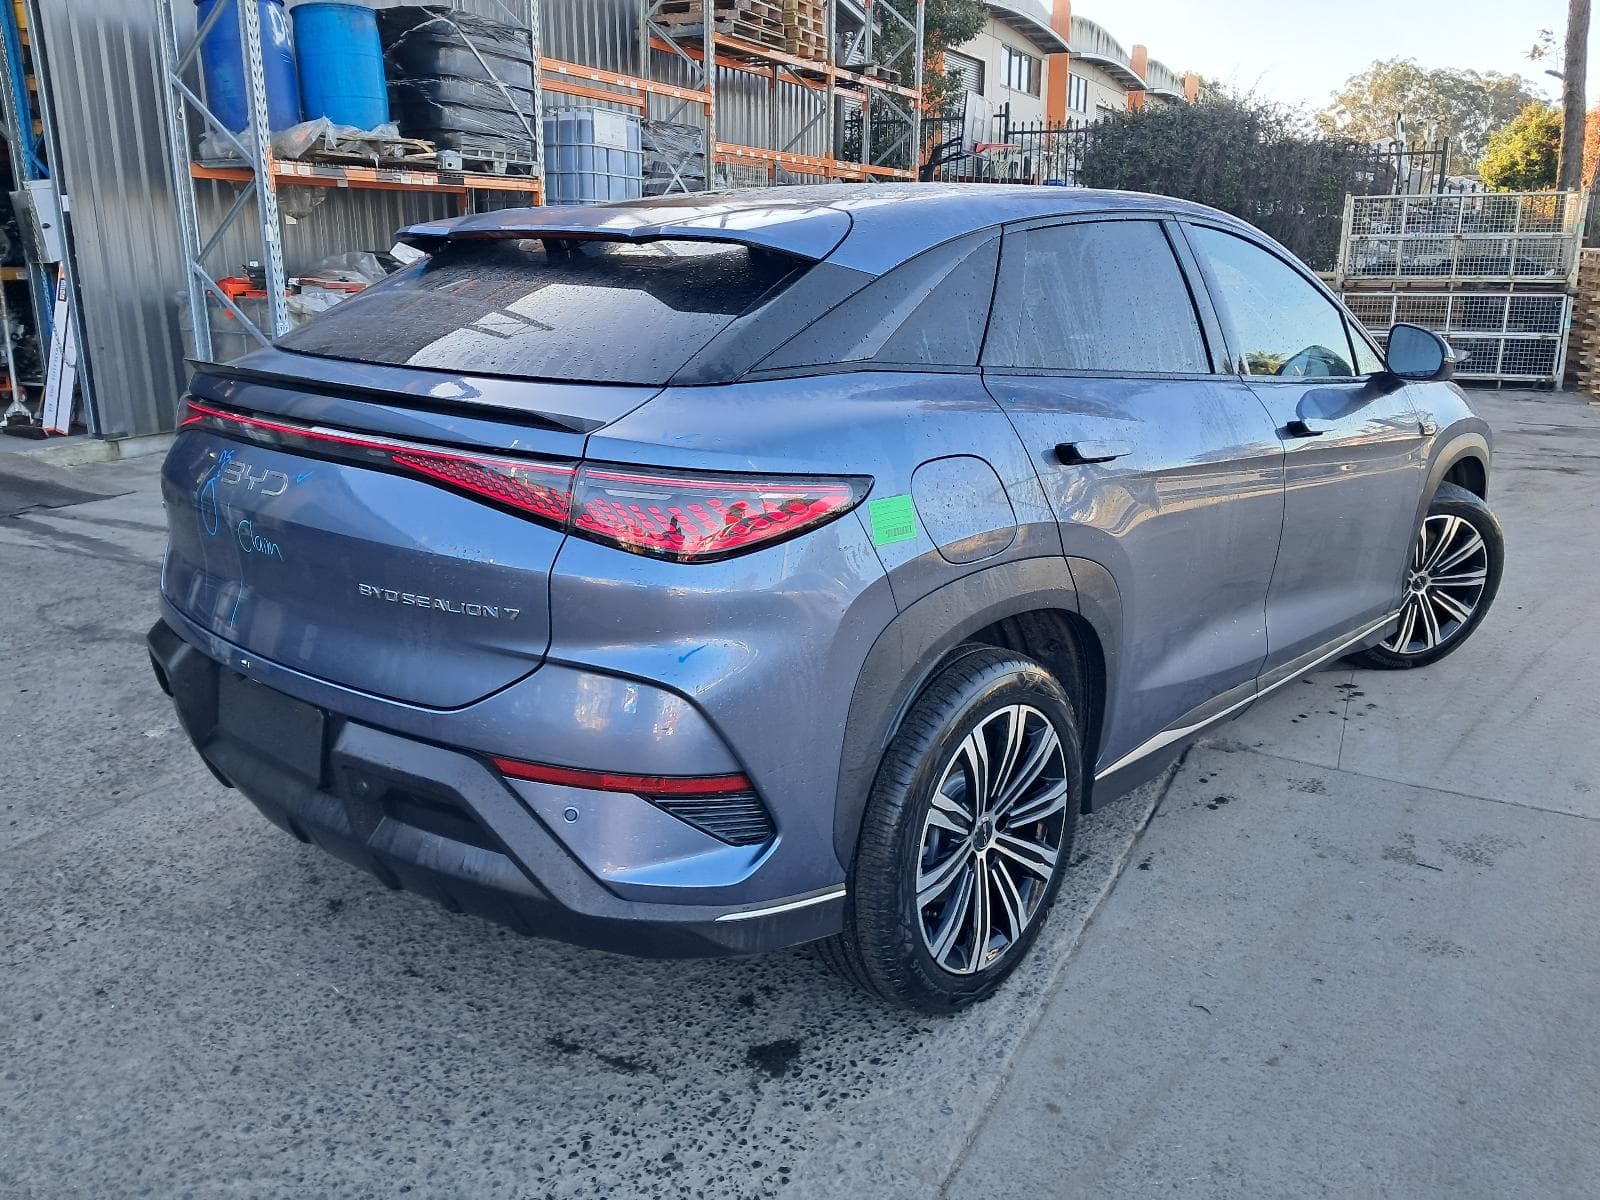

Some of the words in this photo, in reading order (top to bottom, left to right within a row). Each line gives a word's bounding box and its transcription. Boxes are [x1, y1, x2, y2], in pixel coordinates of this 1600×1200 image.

[221, 461, 289, 496] BYD
[238, 519, 283, 561] Claim
[358, 583, 400, 603] BYD
[401, 592, 500, 619] SEALION
[503, 607, 520, 621] 7
